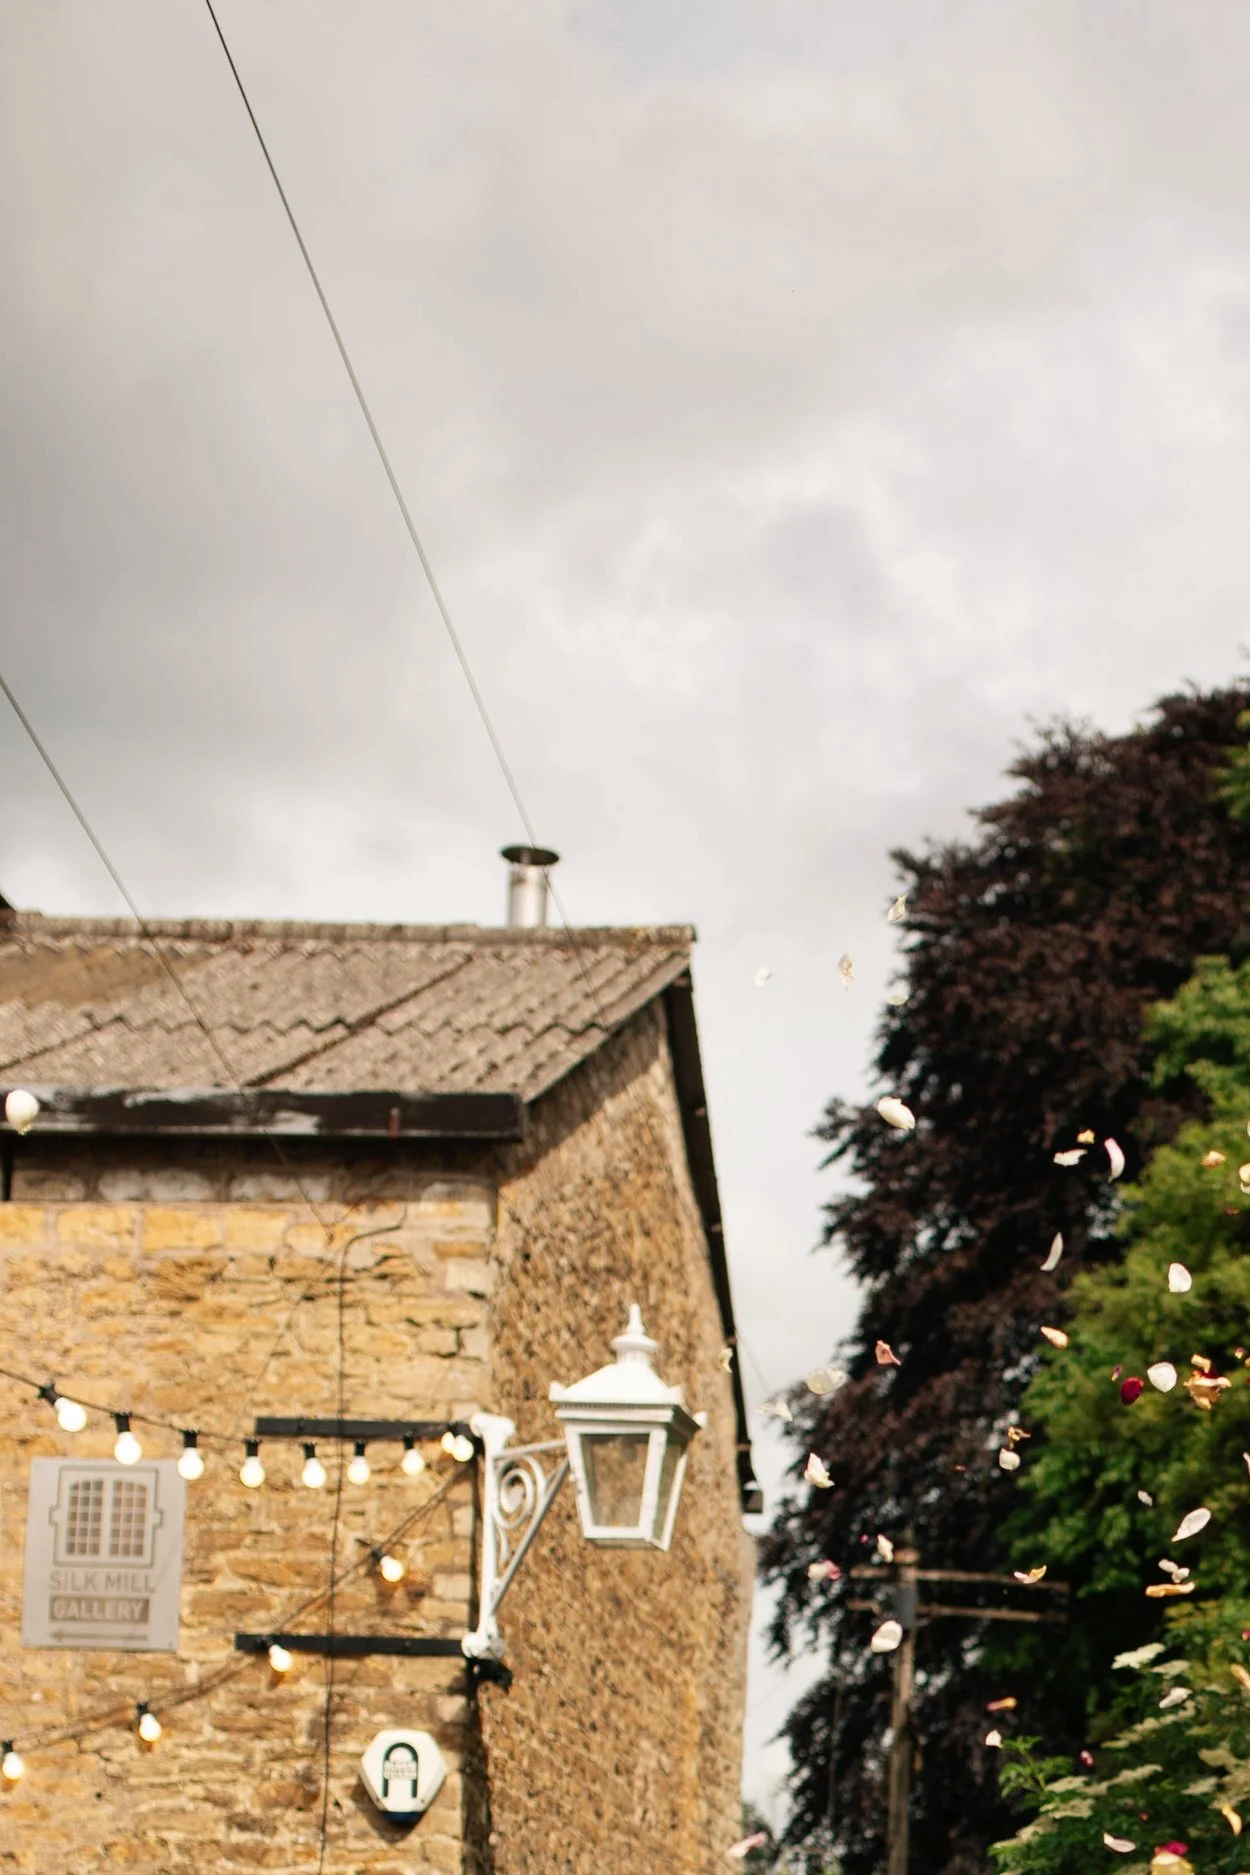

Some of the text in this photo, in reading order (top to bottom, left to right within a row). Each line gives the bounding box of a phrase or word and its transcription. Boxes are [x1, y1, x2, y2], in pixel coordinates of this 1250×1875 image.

[49, 1570, 156, 1594] SILK MILL
[53, 1598, 143, 1620] GALLERY
